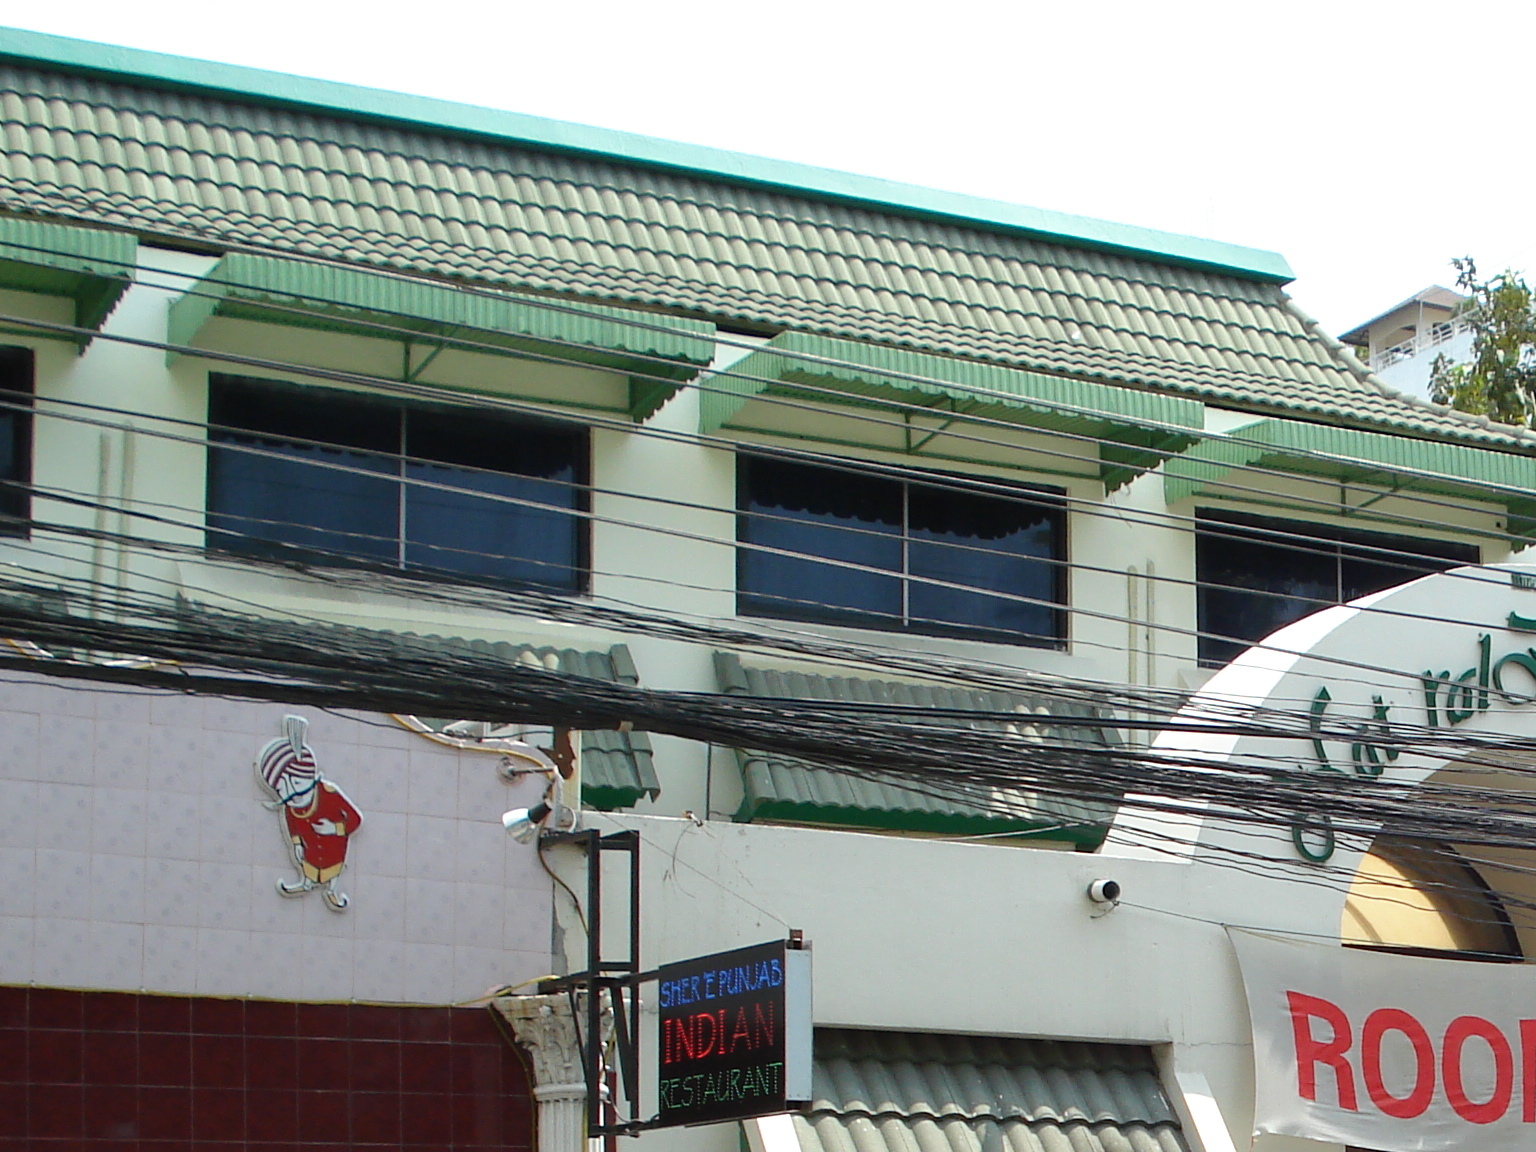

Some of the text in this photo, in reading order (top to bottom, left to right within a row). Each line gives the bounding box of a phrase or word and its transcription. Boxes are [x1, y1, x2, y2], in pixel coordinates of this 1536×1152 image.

[660, 976, 700, 1007] SHER
[718, 959, 783, 997] PUNJAB
[664, 1000, 774, 1064] INDIAN
[660, 1061, 783, 1109] RESTAURANT
